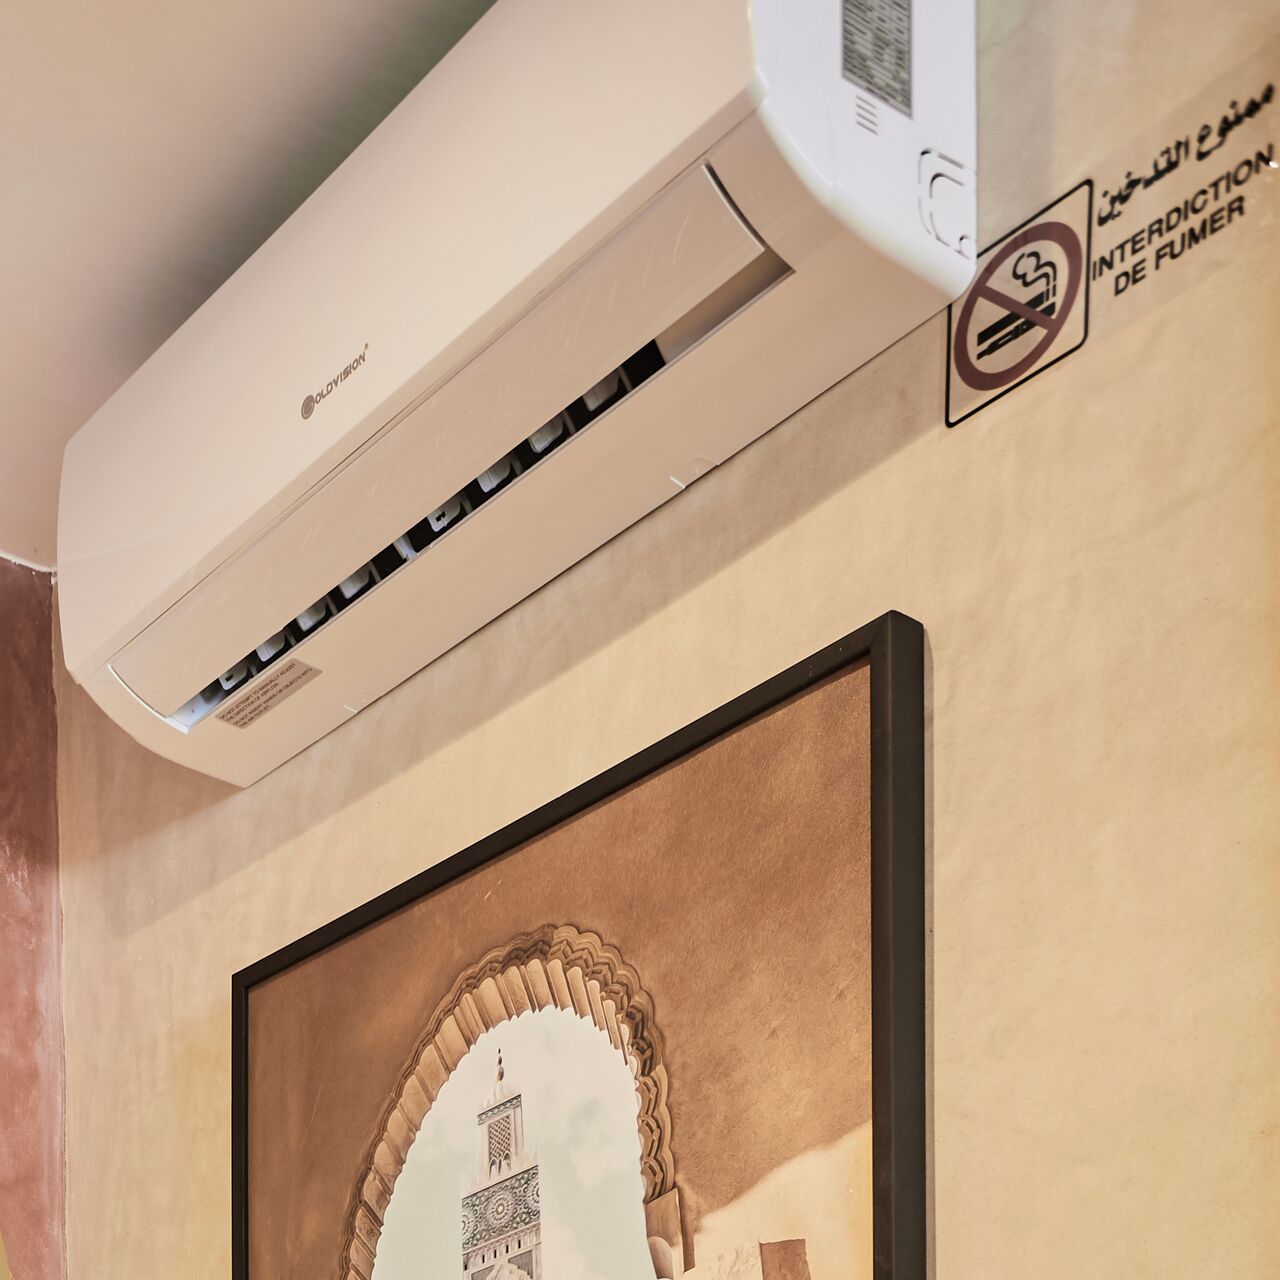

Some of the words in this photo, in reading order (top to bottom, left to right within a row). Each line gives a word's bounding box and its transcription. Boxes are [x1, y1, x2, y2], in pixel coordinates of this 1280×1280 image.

[1196, 83, 1275, 161] ممنوع
[1092, 142, 1274, 281] INTERDICTION
[1097, 135, 1190, 226] التدخين
[1114, 258, 1147, 296] DE
[1155, 195, 1245, 270] FUMER
